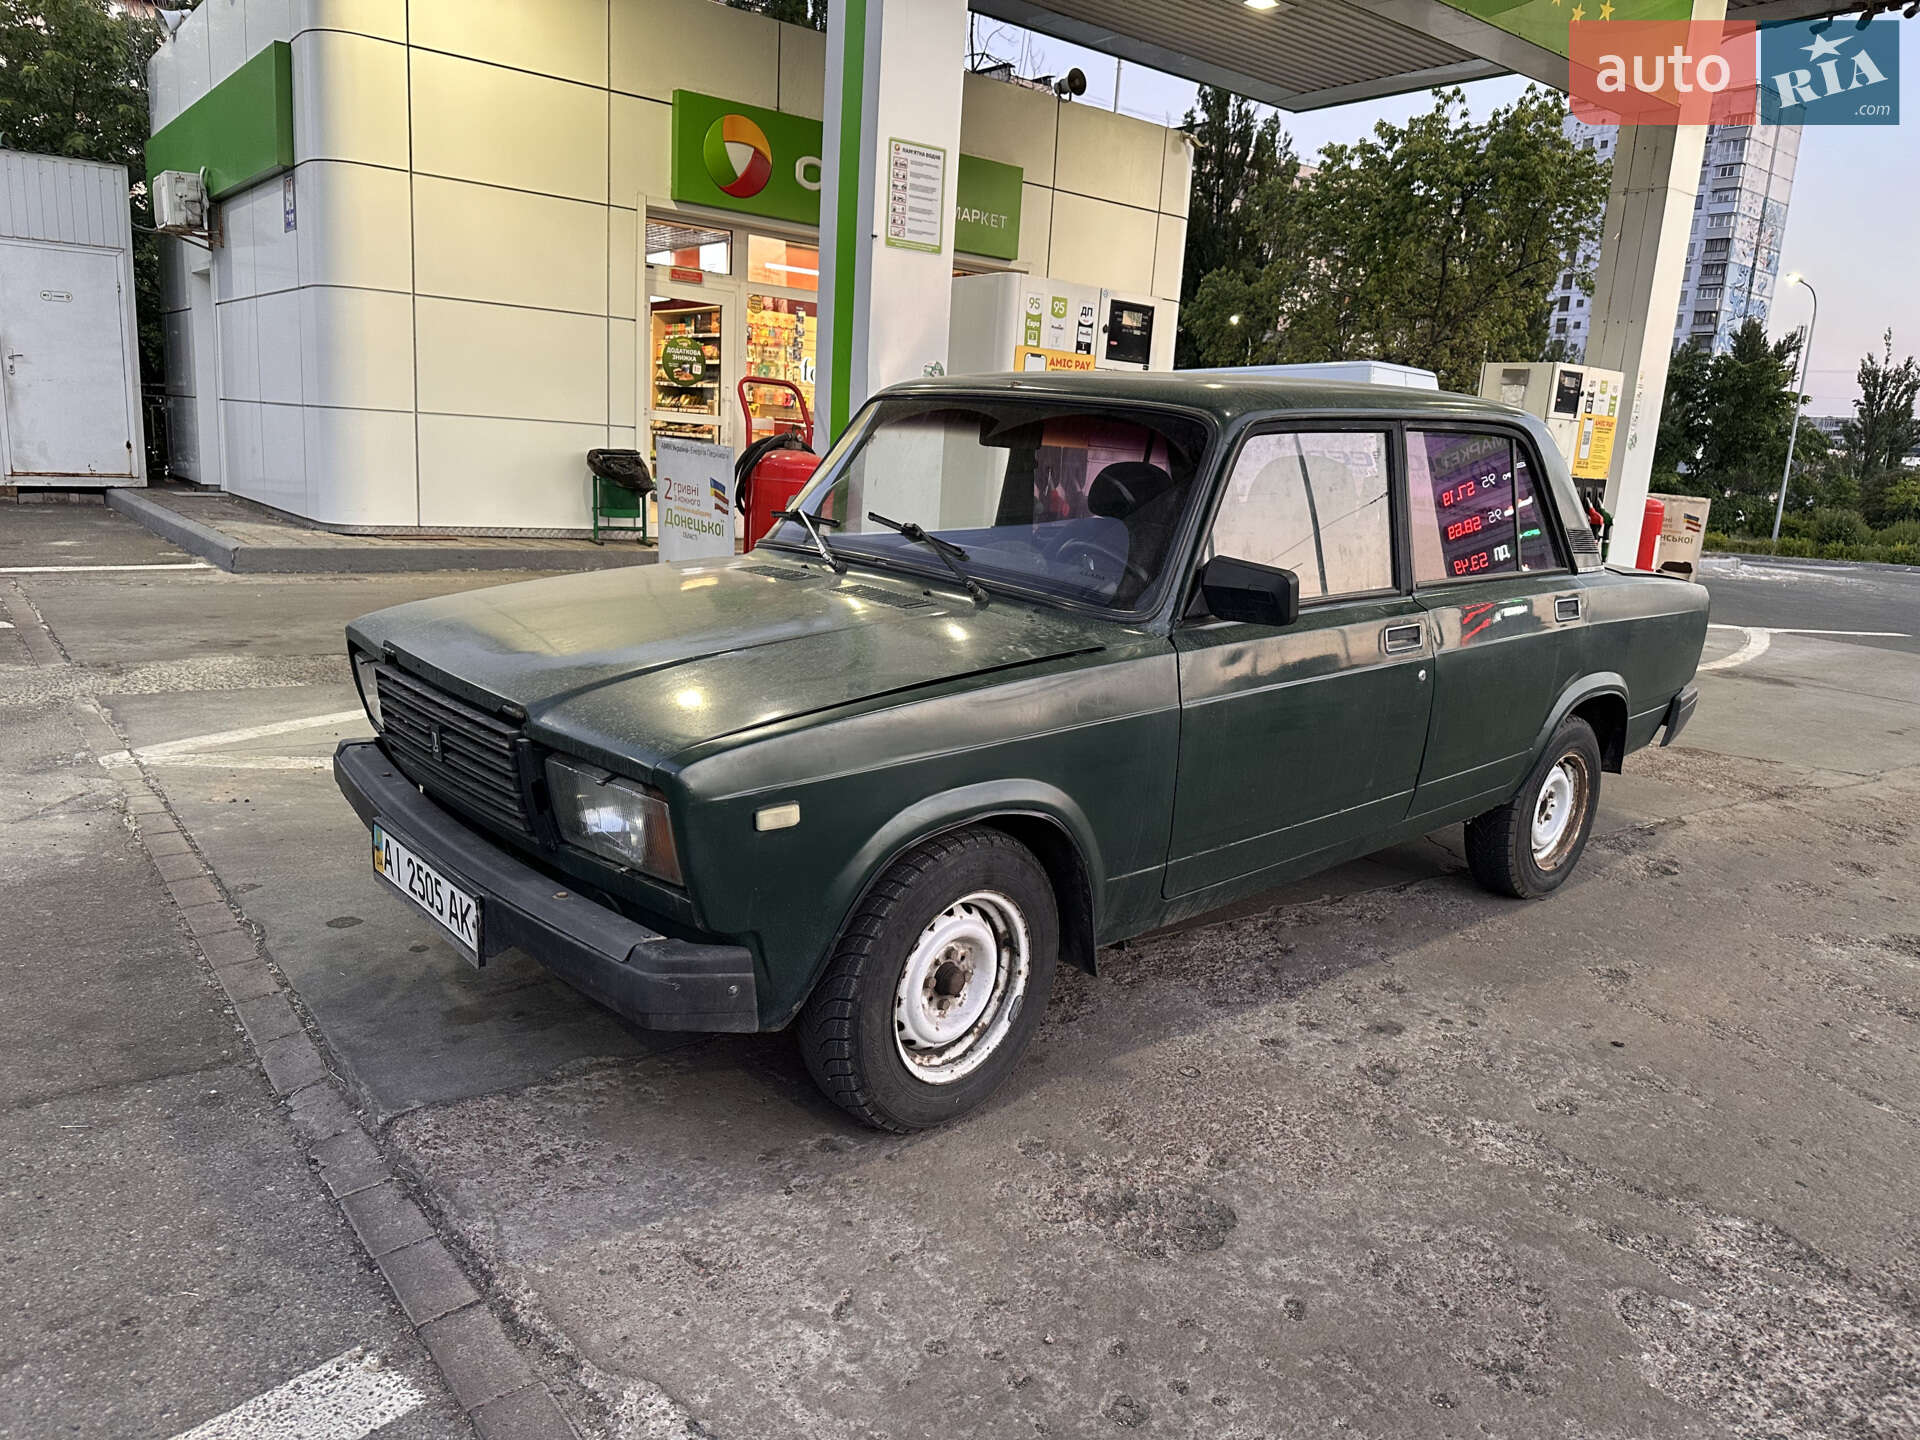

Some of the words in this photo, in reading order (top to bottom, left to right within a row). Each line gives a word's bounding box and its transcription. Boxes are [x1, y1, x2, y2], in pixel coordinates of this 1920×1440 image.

[1028, 297, 1041, 310] 95
[1053, 301, 1065, 314] 95
[1080, 306, 1093, 317] ДП
[666, 346, 701, 356] ДОДАТКОВА
[672, 354, 697, 362] ЗНИЖКА
[1049, 357, 1073, 369] AMIC
[1074, 360, 1091, 371] PAY
[664, 478, 673, 501] 2
[673, 483, 699, 496] гривні
[664, 508, 723, 536] Донецької
[384, 838, 401, 882] AI
[407, 857, 444, 917] 2505
[449, 890, 473, 942] AK
